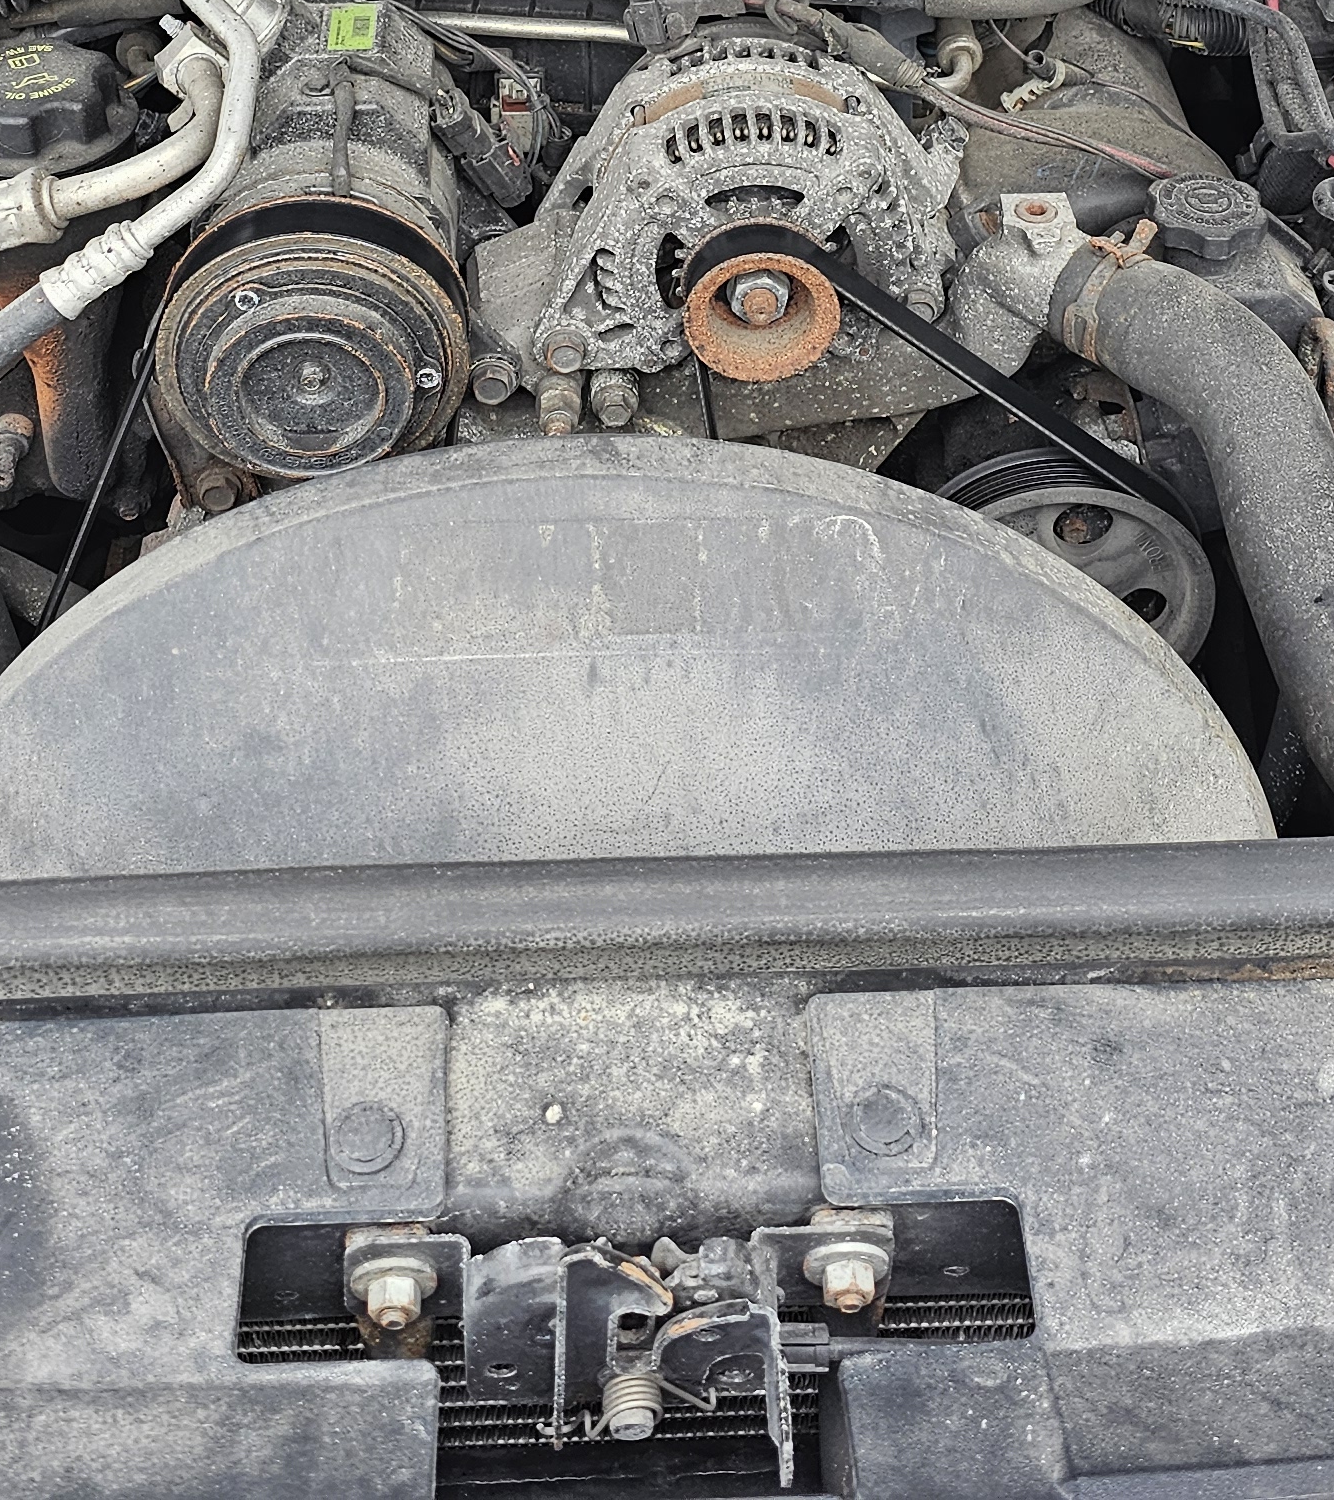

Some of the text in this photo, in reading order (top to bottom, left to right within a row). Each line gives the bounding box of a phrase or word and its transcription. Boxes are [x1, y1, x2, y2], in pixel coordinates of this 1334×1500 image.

[28, 43, 54, 52] SAE
[4, 77, 76, 100] ENGINE OIL
